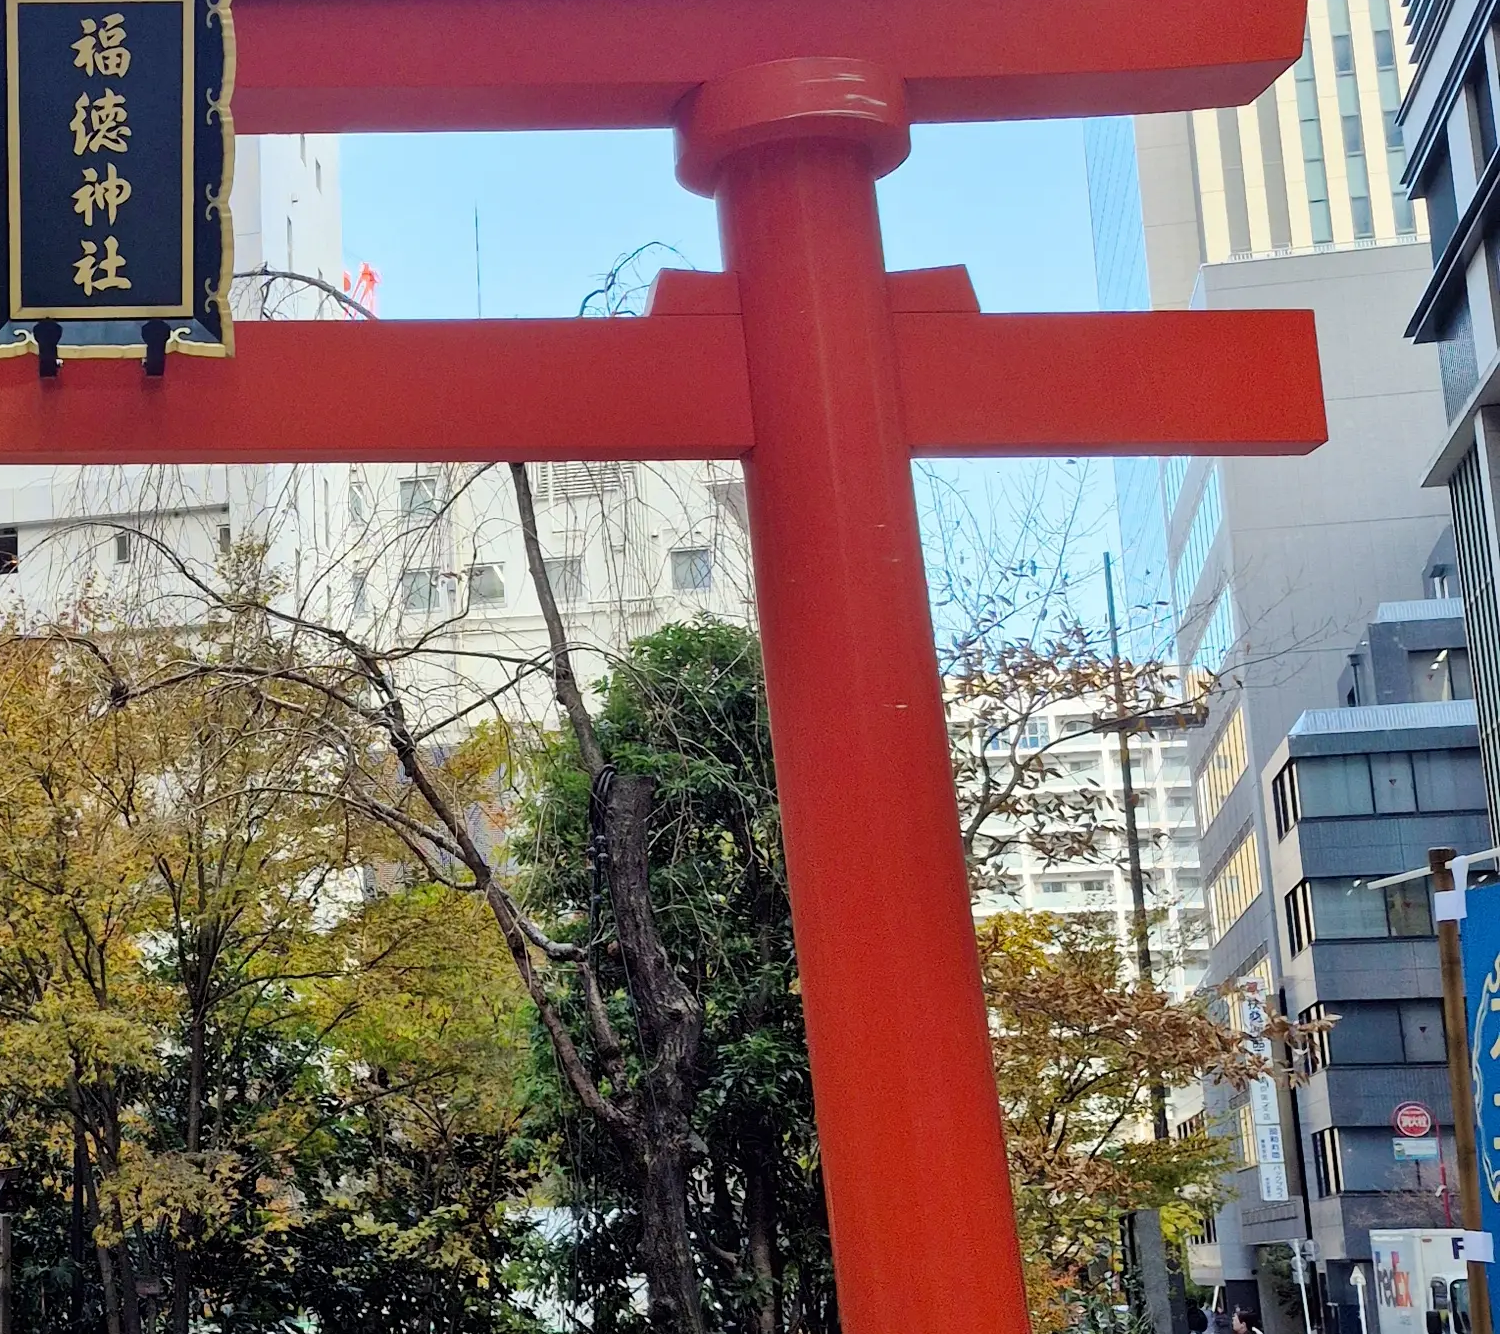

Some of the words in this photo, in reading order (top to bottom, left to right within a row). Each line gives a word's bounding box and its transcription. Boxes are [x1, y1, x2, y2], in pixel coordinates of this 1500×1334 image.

[70, 13, 133, 297] 福徳神社
[1374, 1251, 1413, 1308] FedEx
